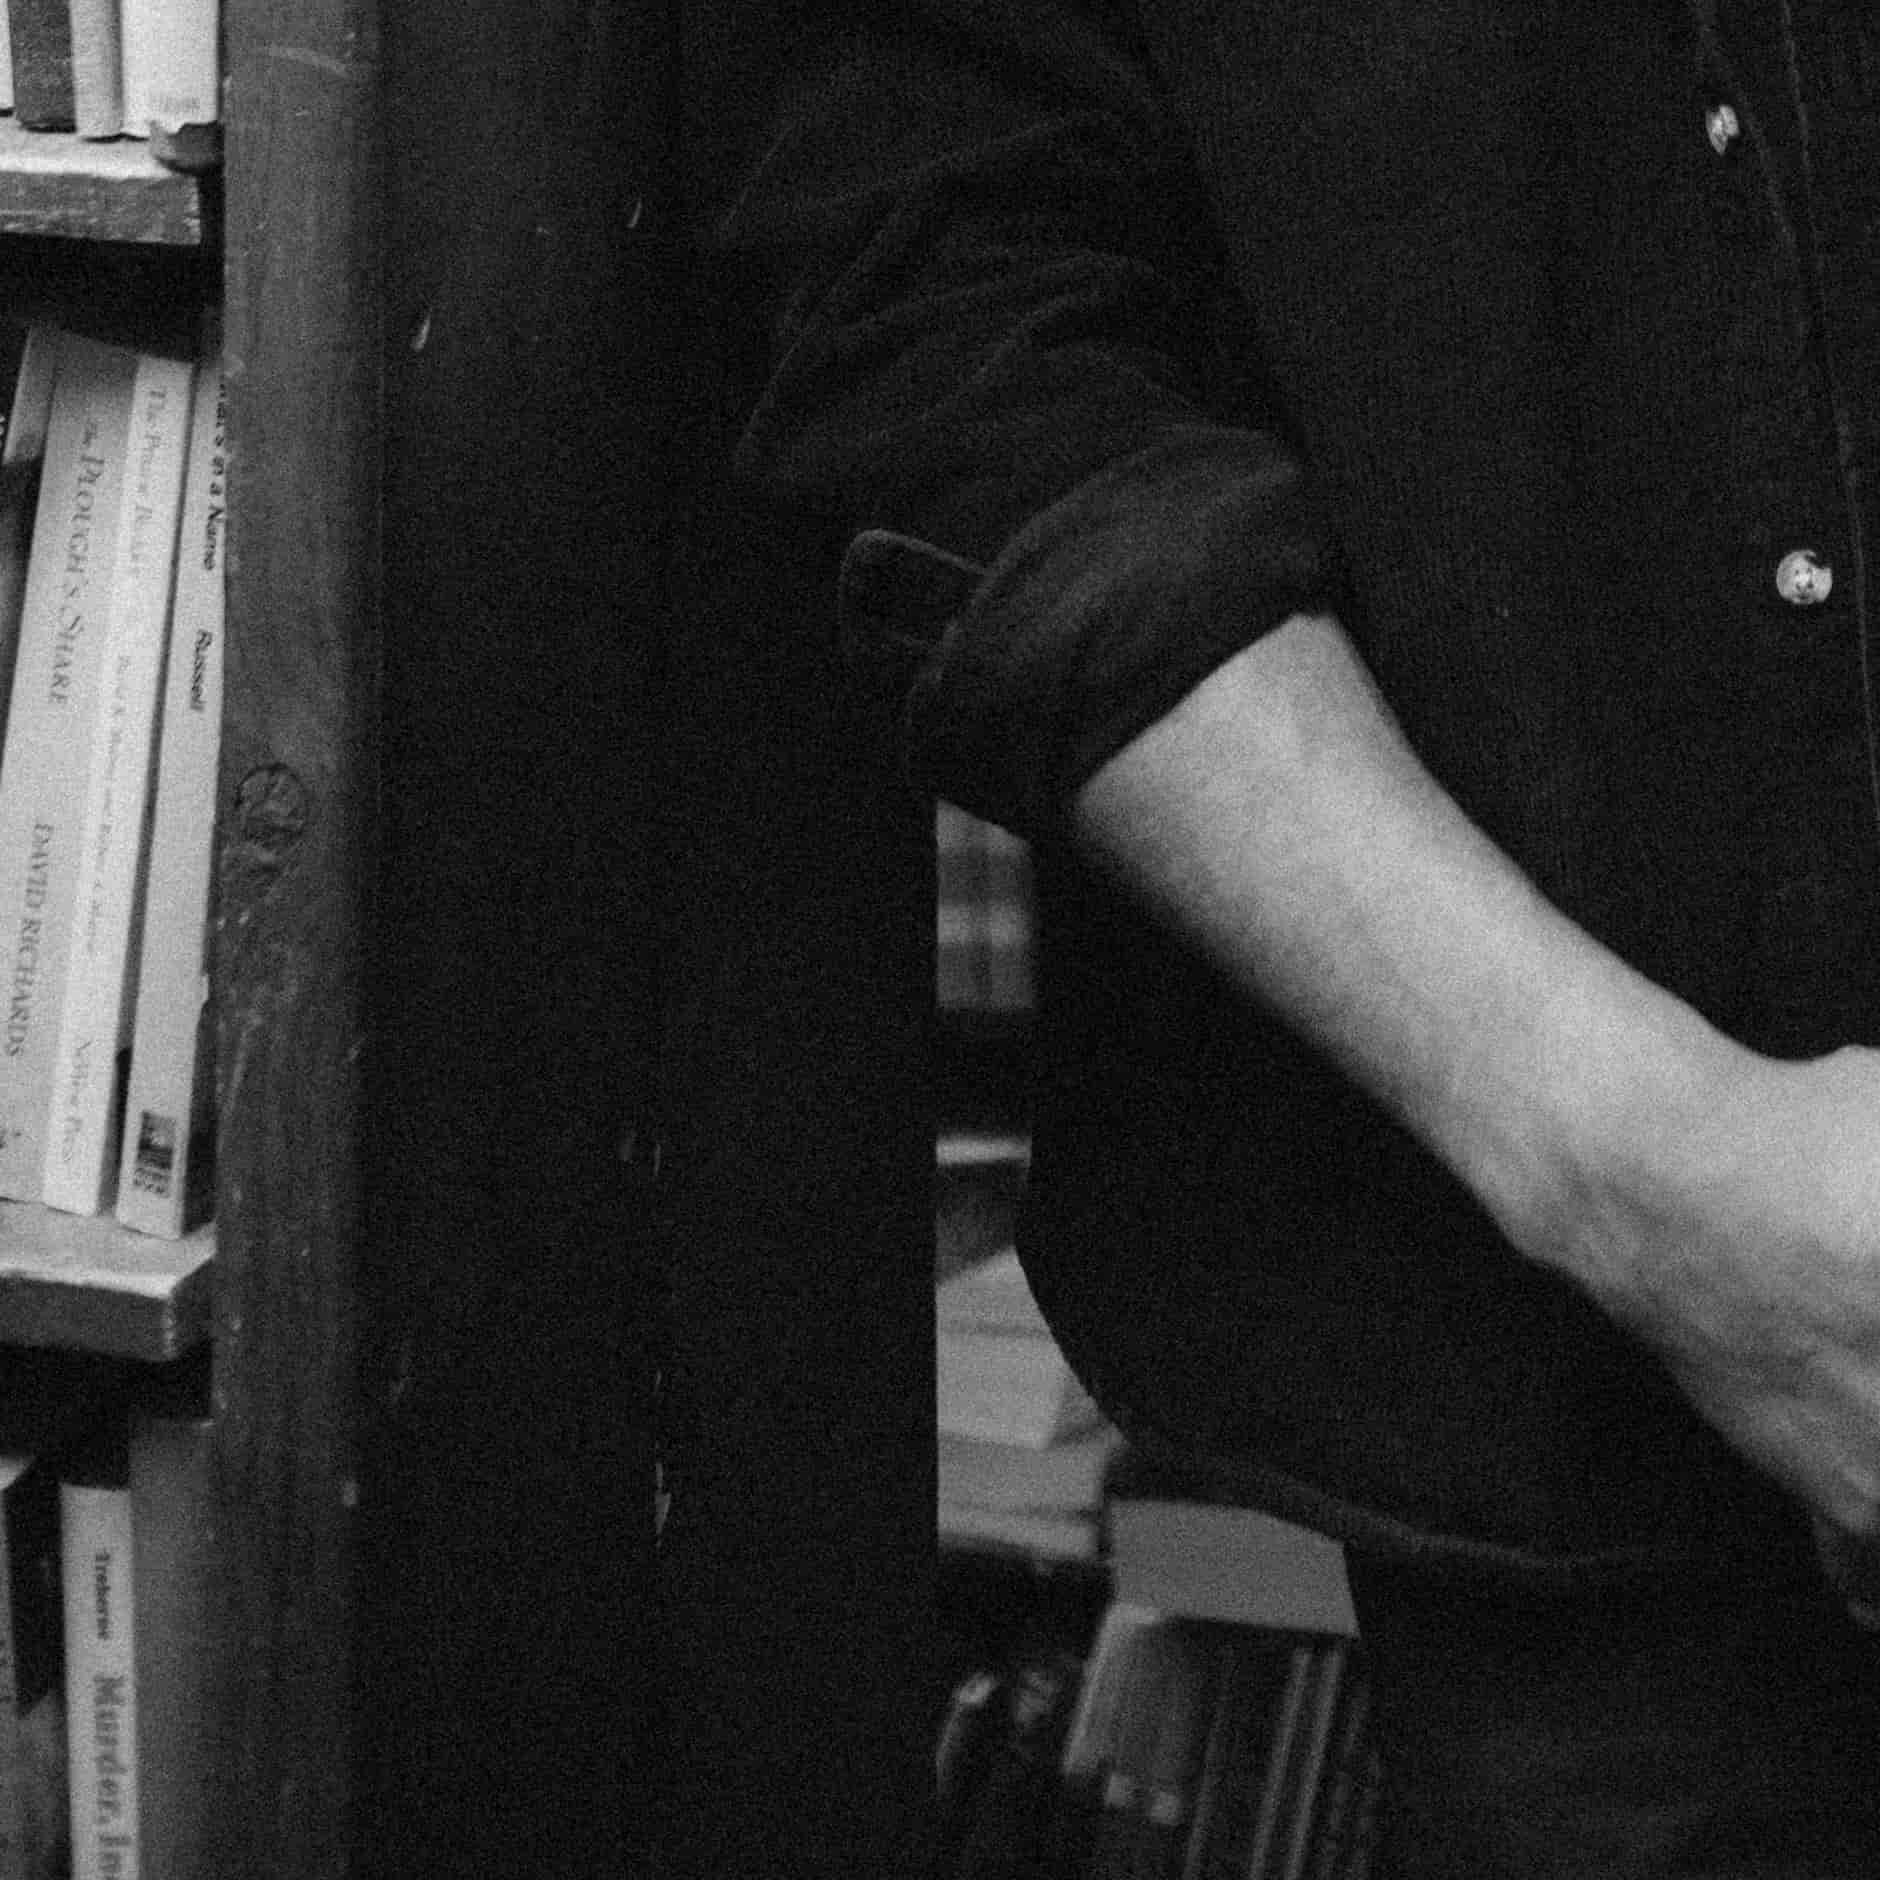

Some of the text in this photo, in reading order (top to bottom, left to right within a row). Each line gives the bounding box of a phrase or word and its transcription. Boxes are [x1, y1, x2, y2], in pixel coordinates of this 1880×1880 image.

[203, 505, 226, 572] Name
[189, 630, 214, 713] Russell
[4, 820, 55, 1058] DAVID RICHARDS
